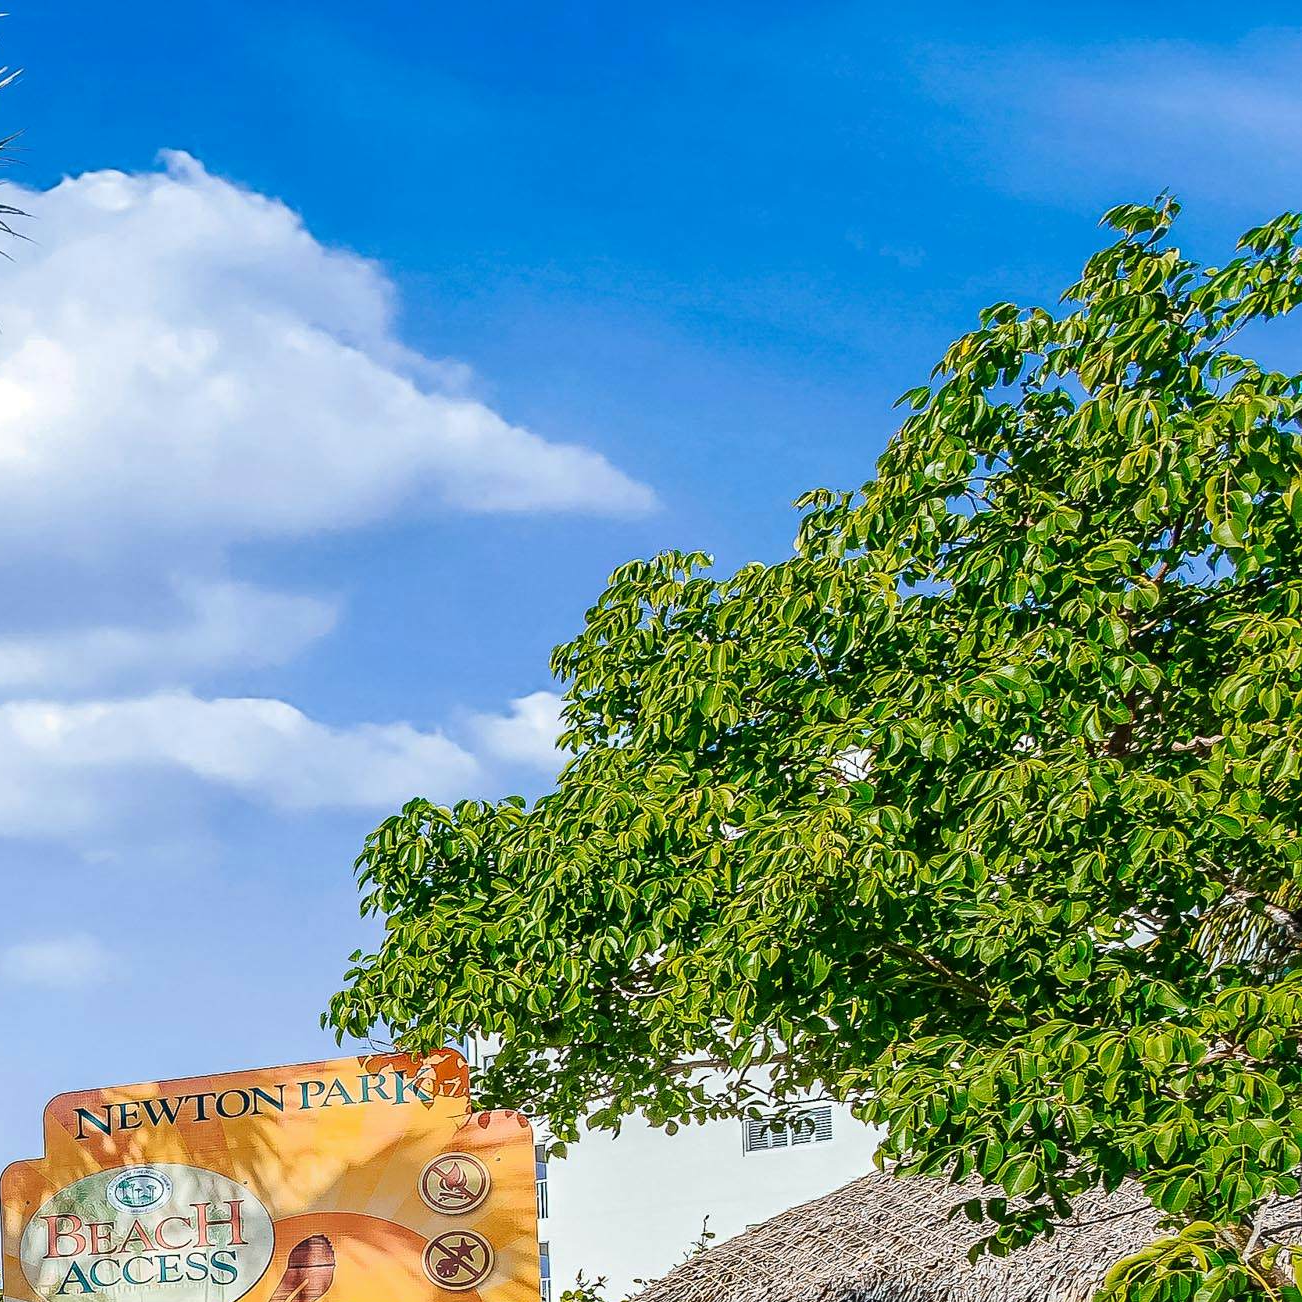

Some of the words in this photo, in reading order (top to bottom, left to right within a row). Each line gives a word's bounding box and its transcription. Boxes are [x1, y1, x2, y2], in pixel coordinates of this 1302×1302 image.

[74, 1083, 284, 1140] NEWTON
[297, 1068, 436, 1109] PARK
[41, 1199, 249, 1259] BEACH
[56, 1250, 239, 1296] ACCESS
